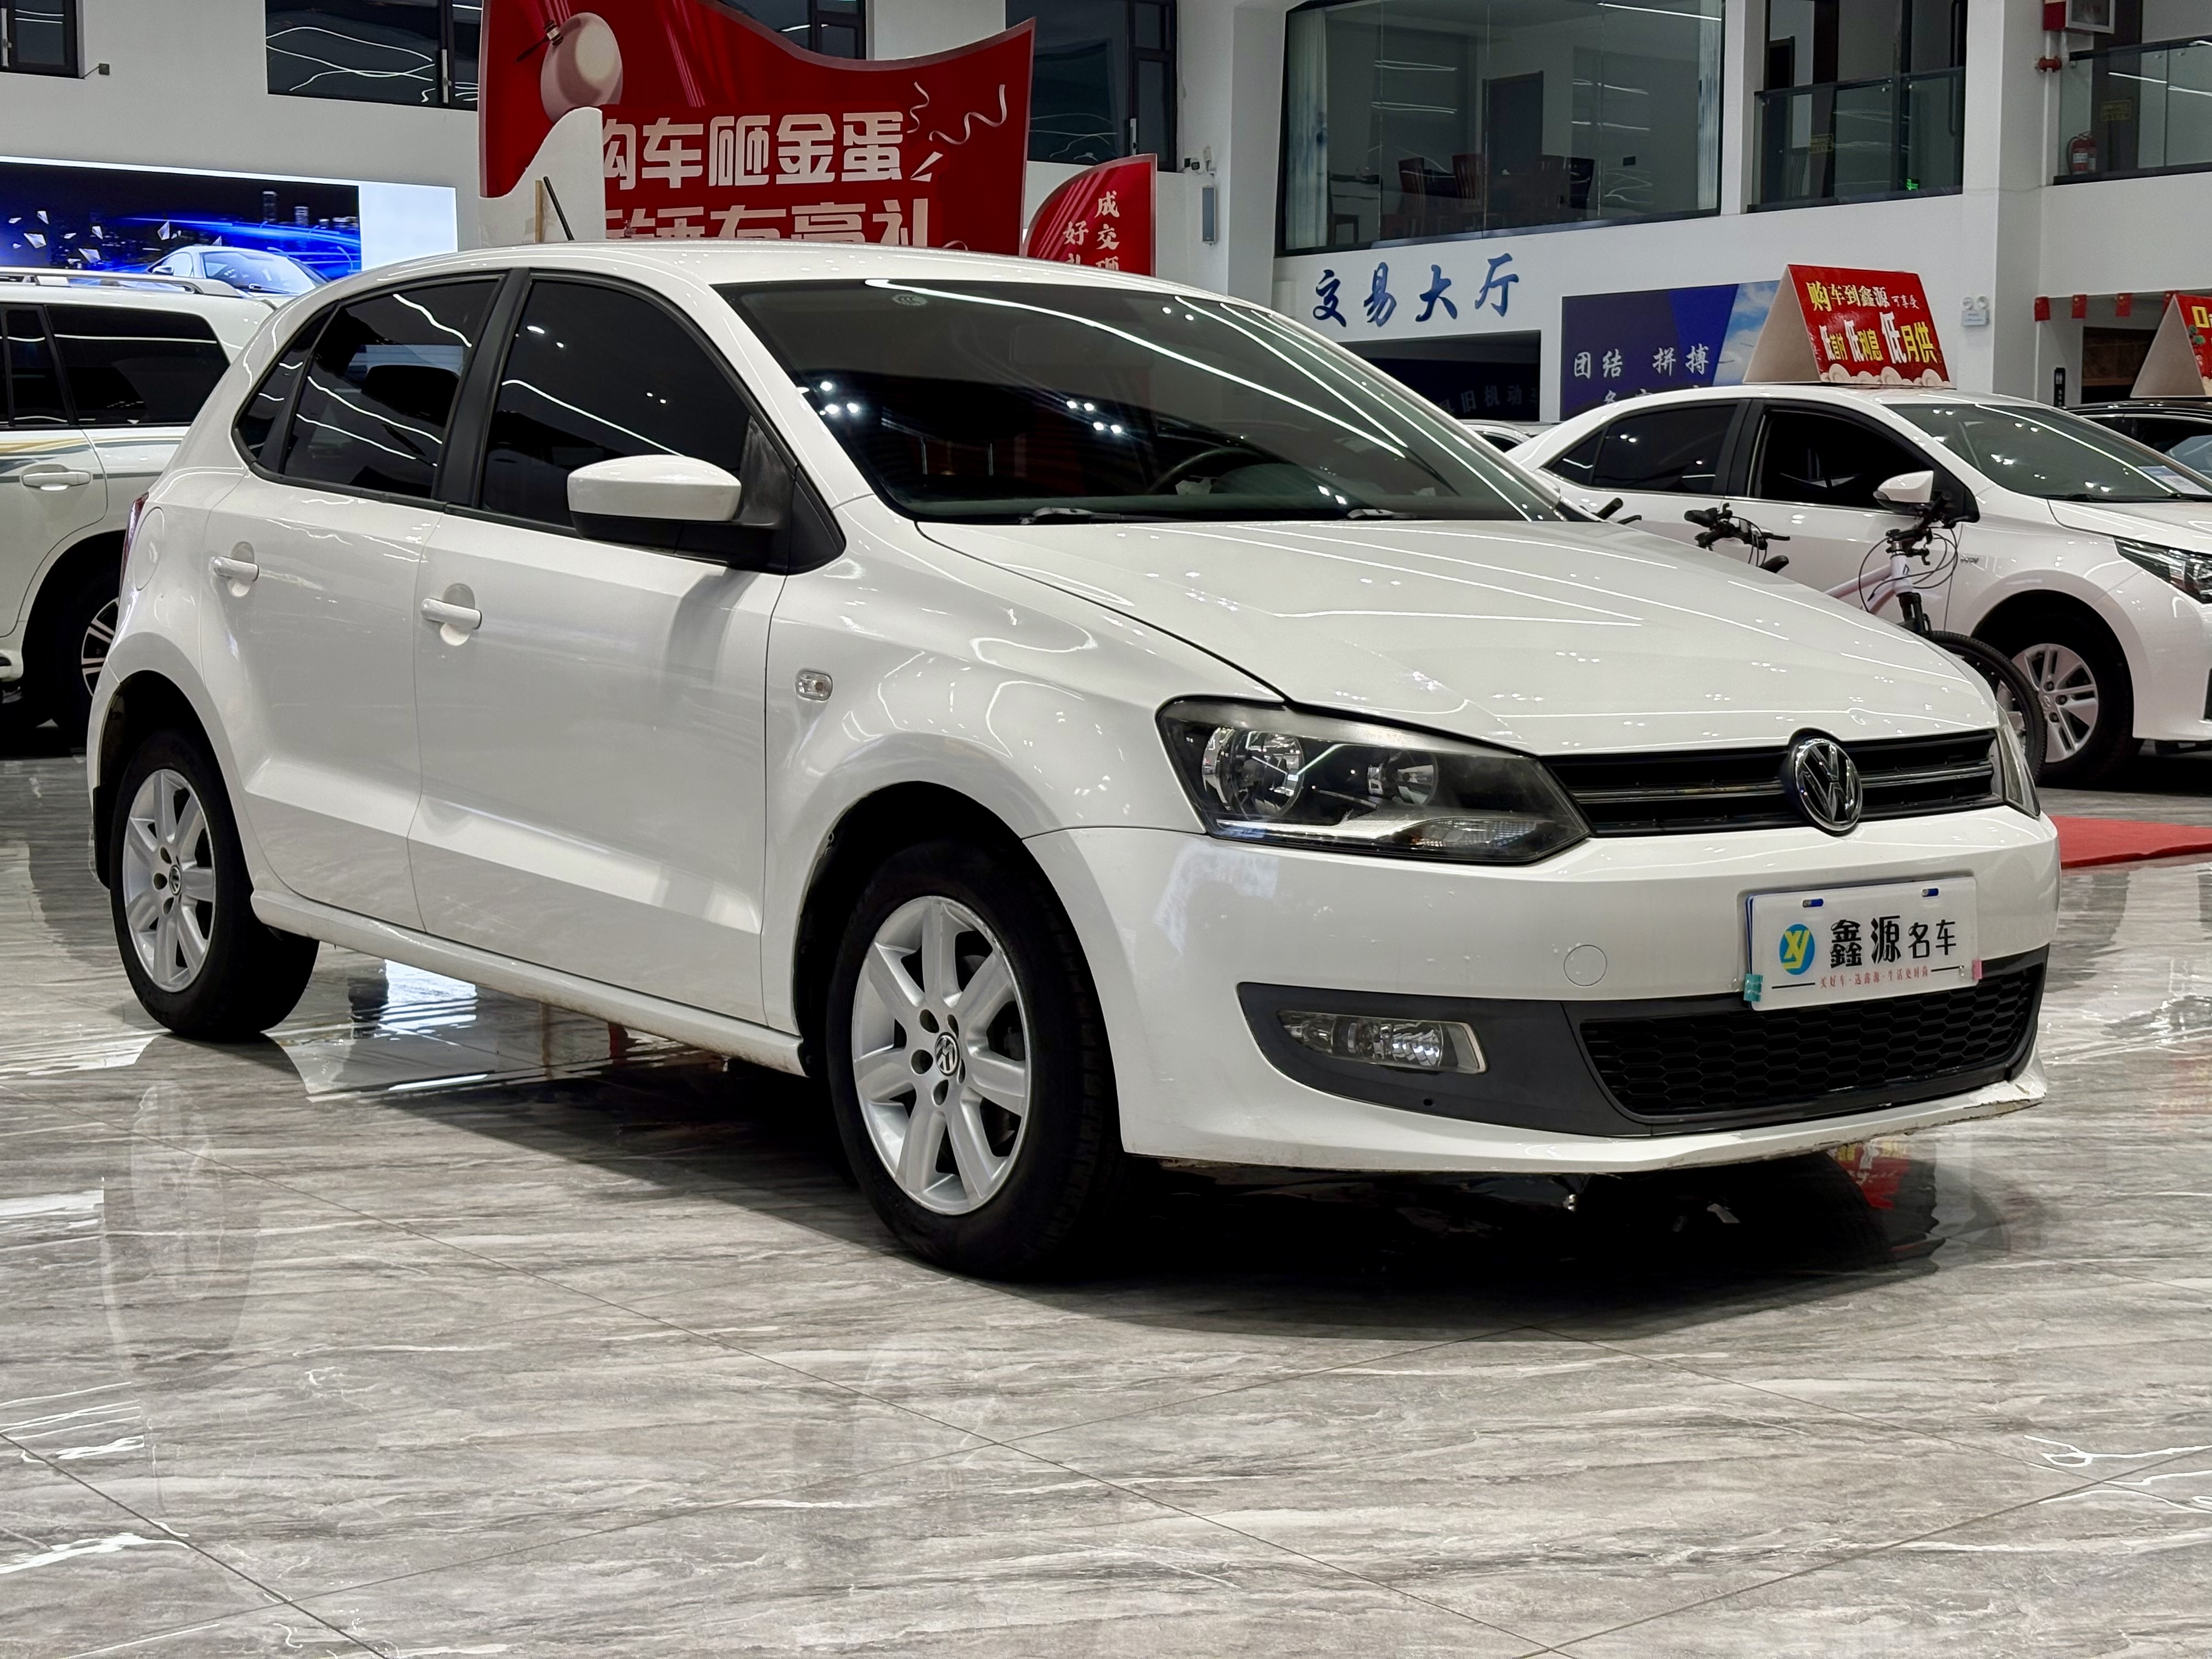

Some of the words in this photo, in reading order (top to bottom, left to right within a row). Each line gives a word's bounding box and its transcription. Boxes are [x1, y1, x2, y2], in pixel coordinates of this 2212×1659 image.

[1313, 253, 1519, 328] 交易大厅
[1830, 915, 1957, 969] 鑫源名车
